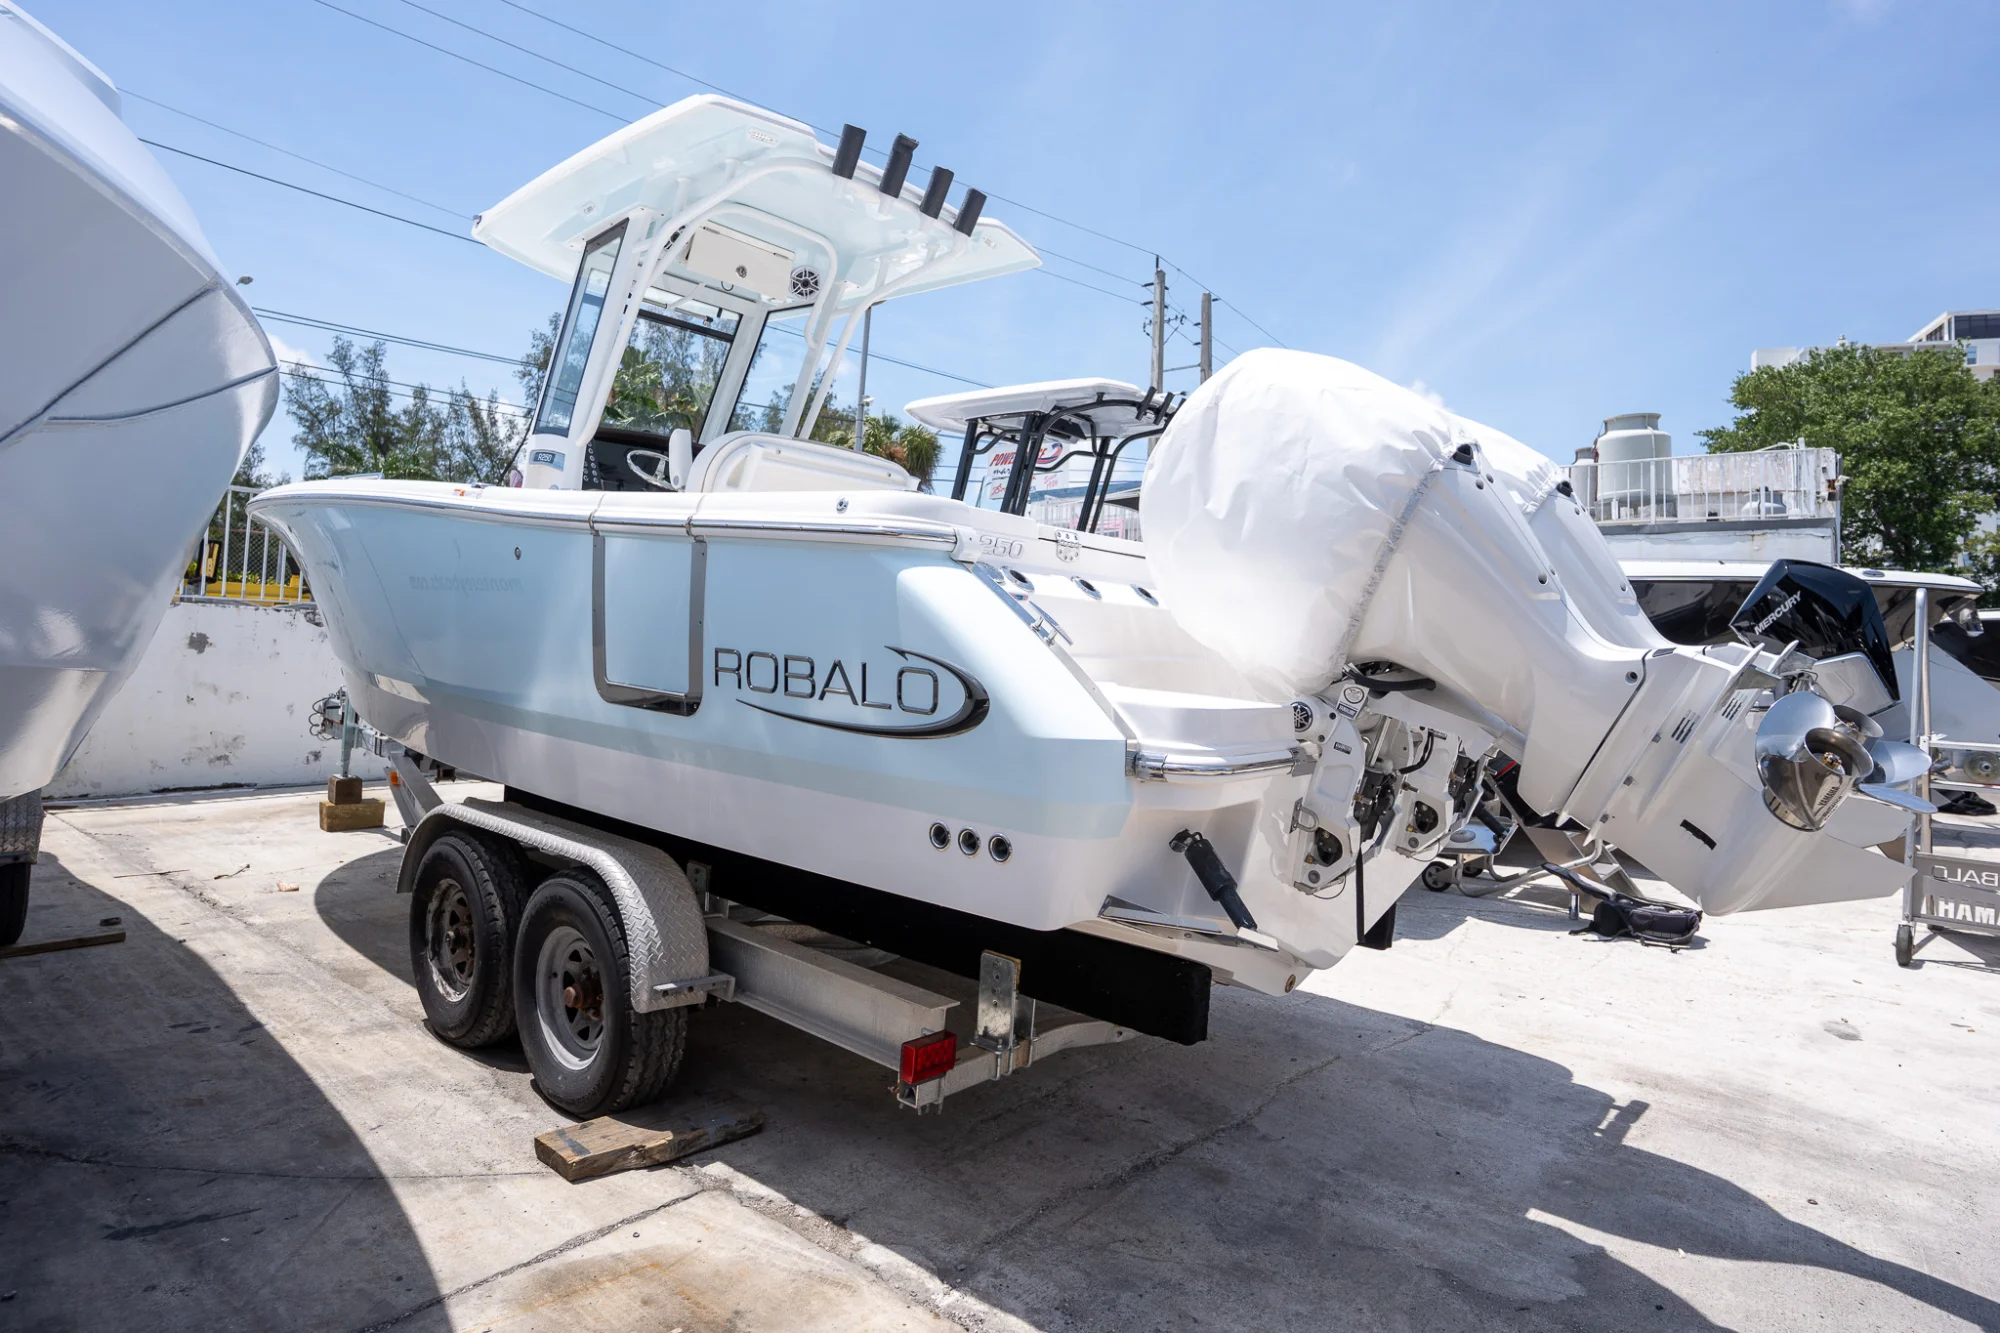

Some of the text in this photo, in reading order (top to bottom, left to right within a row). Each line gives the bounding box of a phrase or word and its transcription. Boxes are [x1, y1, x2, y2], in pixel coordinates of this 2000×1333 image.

[980, 535, 1023, 559] 250
[1753, 591, 1802, 636] MERCURY
[714, 647, 940, 716] ROBALO
[1817, 786, 1841, 806] YAMAHA
